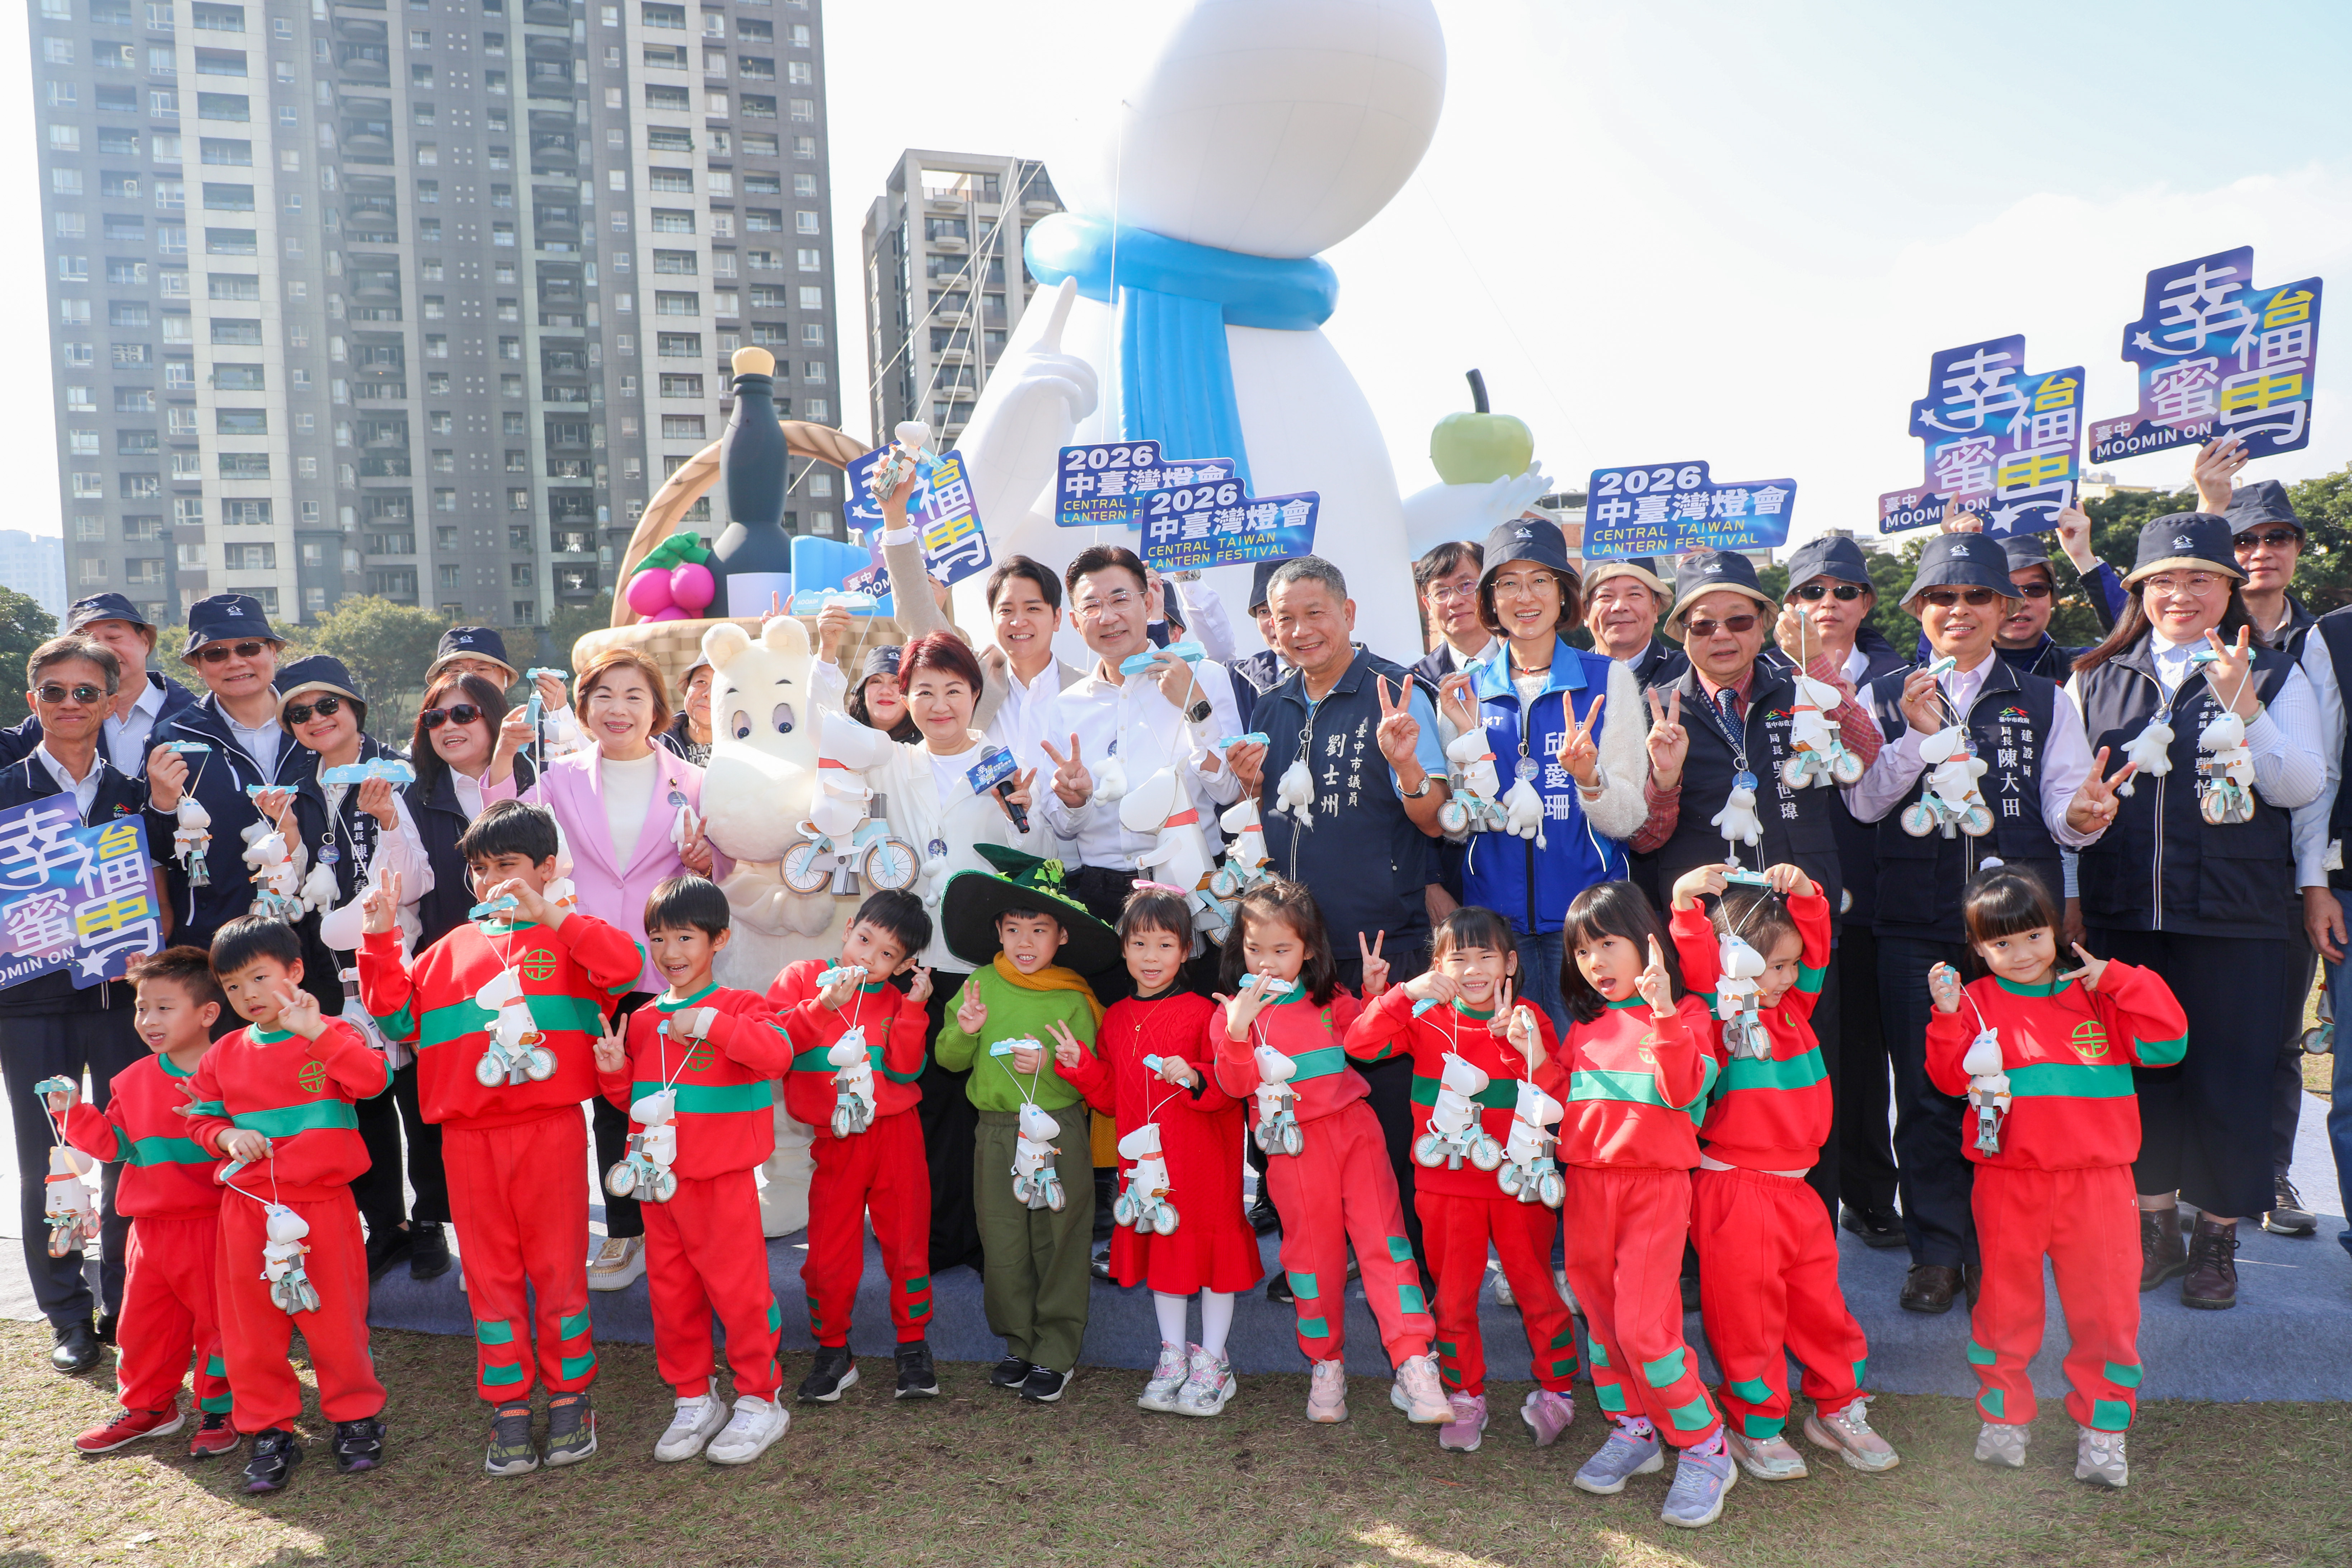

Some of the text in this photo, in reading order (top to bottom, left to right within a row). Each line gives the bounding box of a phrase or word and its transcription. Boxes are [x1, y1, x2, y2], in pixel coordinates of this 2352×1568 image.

[2095, 421, 2131, 443] 臺中
[2096, 421, 2212, 458] MOOMIN ON
[1066, 446, 1153, 470] 2026
[1065, 465, 1228, 498] 中臺灣燈會
[1597, 465, 1701, 496] 2026
[1064, 498, 1127, 511] CENTRAL
[1151, 483, 1238, 515] 2026
[1596, 485, 1789, 527] 中臺灣燈會
[1885, 493, 1917, 513] 臺中
[1965, 497, 1990, 513] ON
[1063, 510, 1126, 523] LANTERN
[1150, 498, 1313, 543] 中臺灣燈會
[1593, 520, 1745, 541] CENTRAL TAIWAN
[1148, 532, 1276, 557] CENTRAL TAIWAN
[1592, 532, 1759, 555] LANTERN FESTIVAL
[1147, 544, 1288, 569] LANTERN FESTIVAL
[847, 572, 872, 591] 臺中
[1715, 715, 1729, 738] TAICHUNG
[1726, 733, 1736, 744] CITY
[1769, 733, 1783, 755] 局長
[2021, 729, 2033, 777] 建設局
[1321, 733, 1347, 817] 劉士州
[1347, 724, 1367, 807] 臺中市議員
[1997, 727, 2020, 817] 局長 陳大田
[353, 821, 364, 841] 處長
[48, 947, 75, 965] ON
[1611, 1431, 1637, 1445] KECHERS
